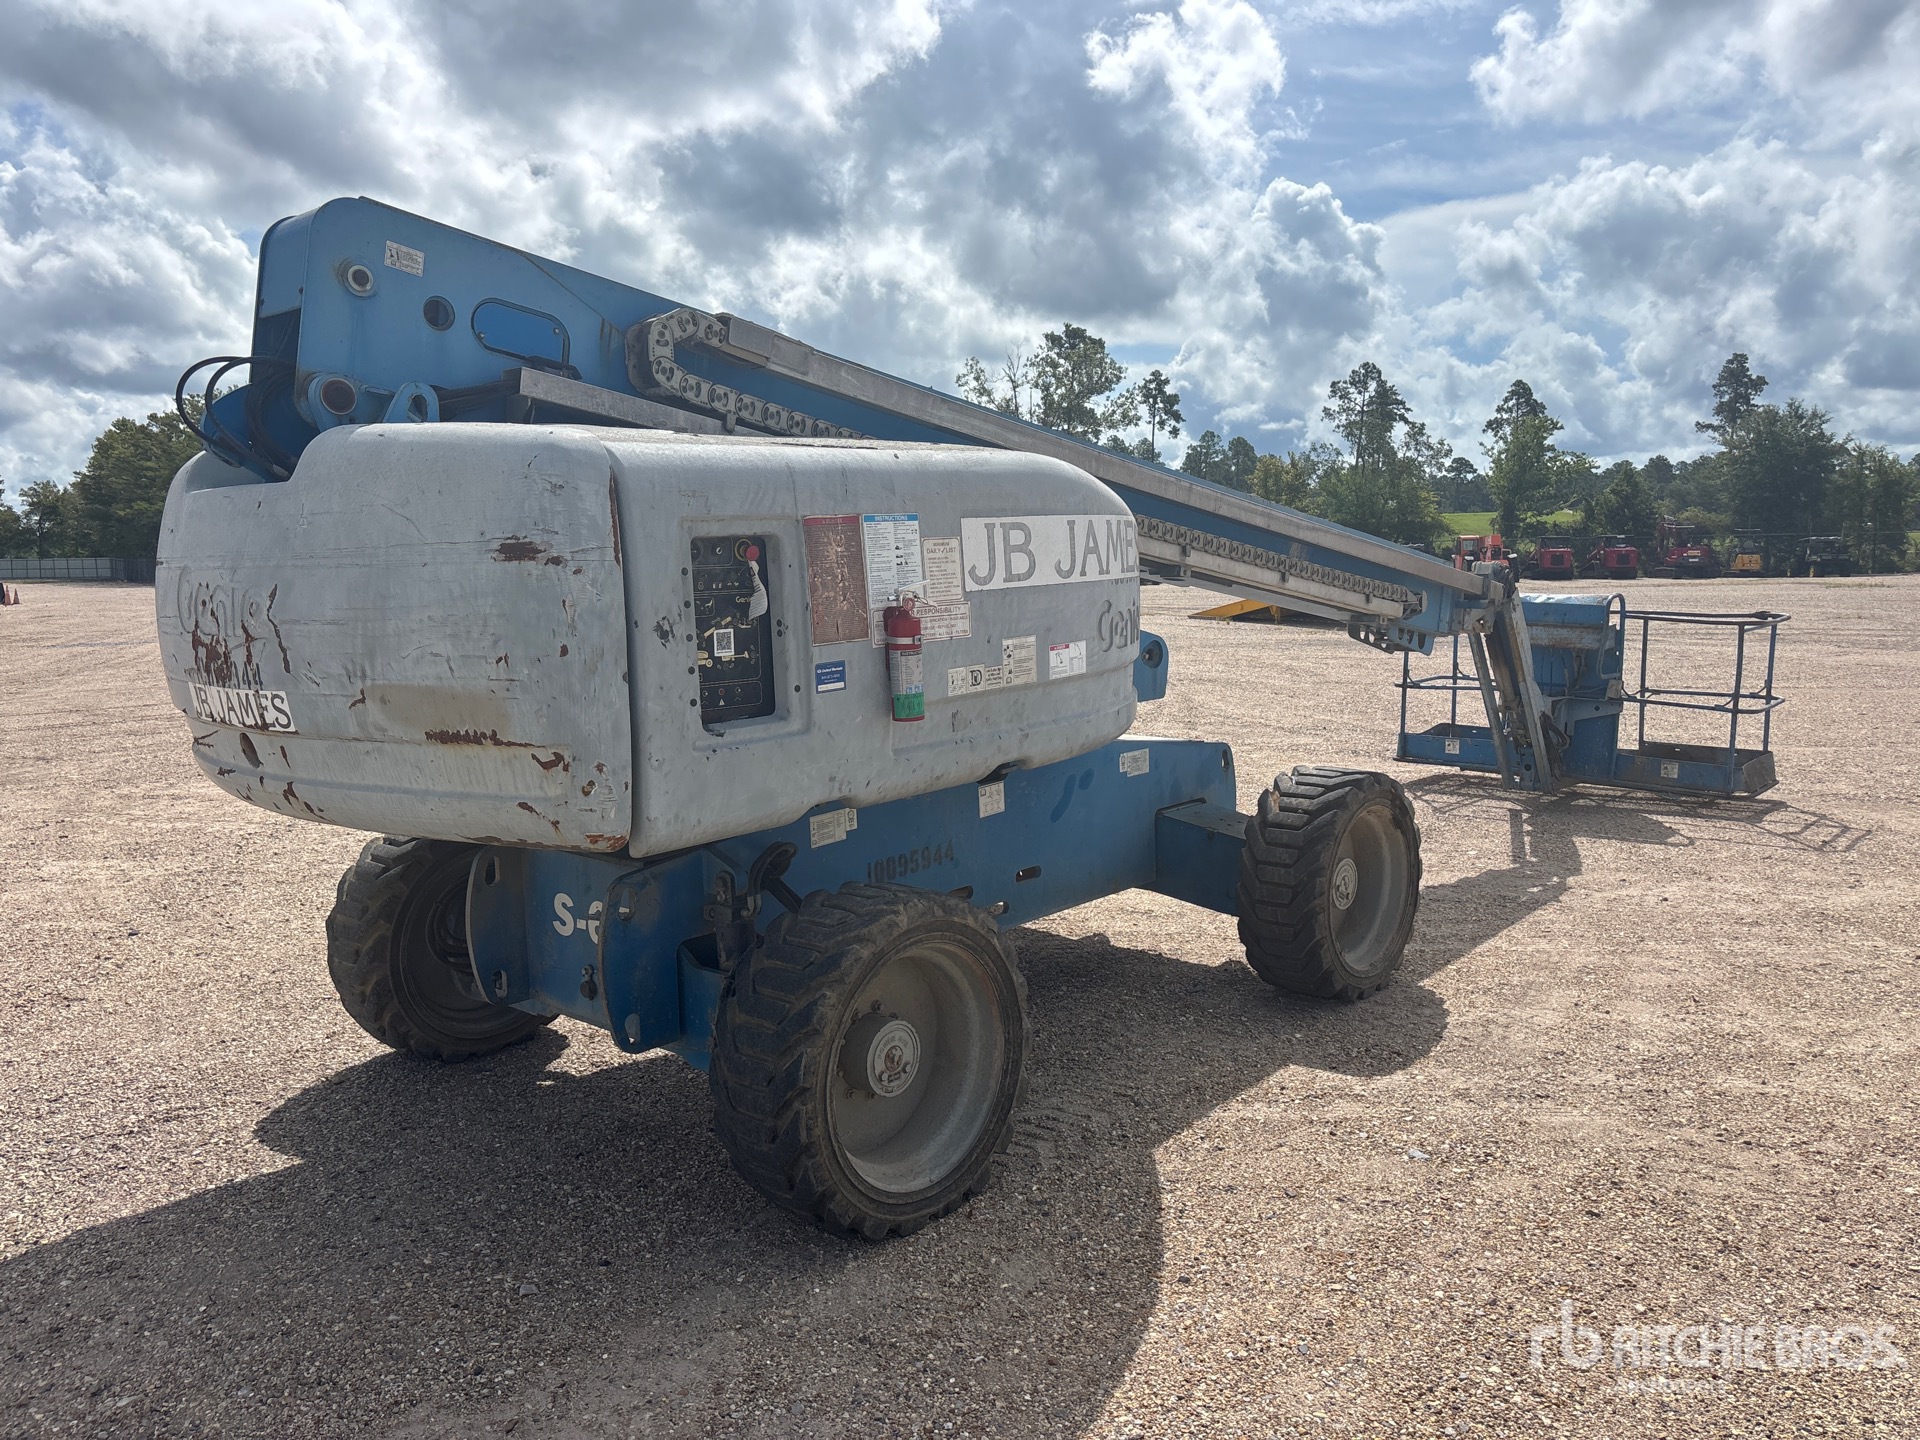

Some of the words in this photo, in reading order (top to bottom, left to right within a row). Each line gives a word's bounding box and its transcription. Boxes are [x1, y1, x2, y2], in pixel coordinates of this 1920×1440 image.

[967, 521, 1037, 587] JB
[735, 595, 752, 604] Geni
[916, 606, 962, 616] RESPONSIBILITY
[194, 683, 217, 721] JB
[217, 689, 292, 730] JAMES
[866, 840, 955, 884] 10095944
